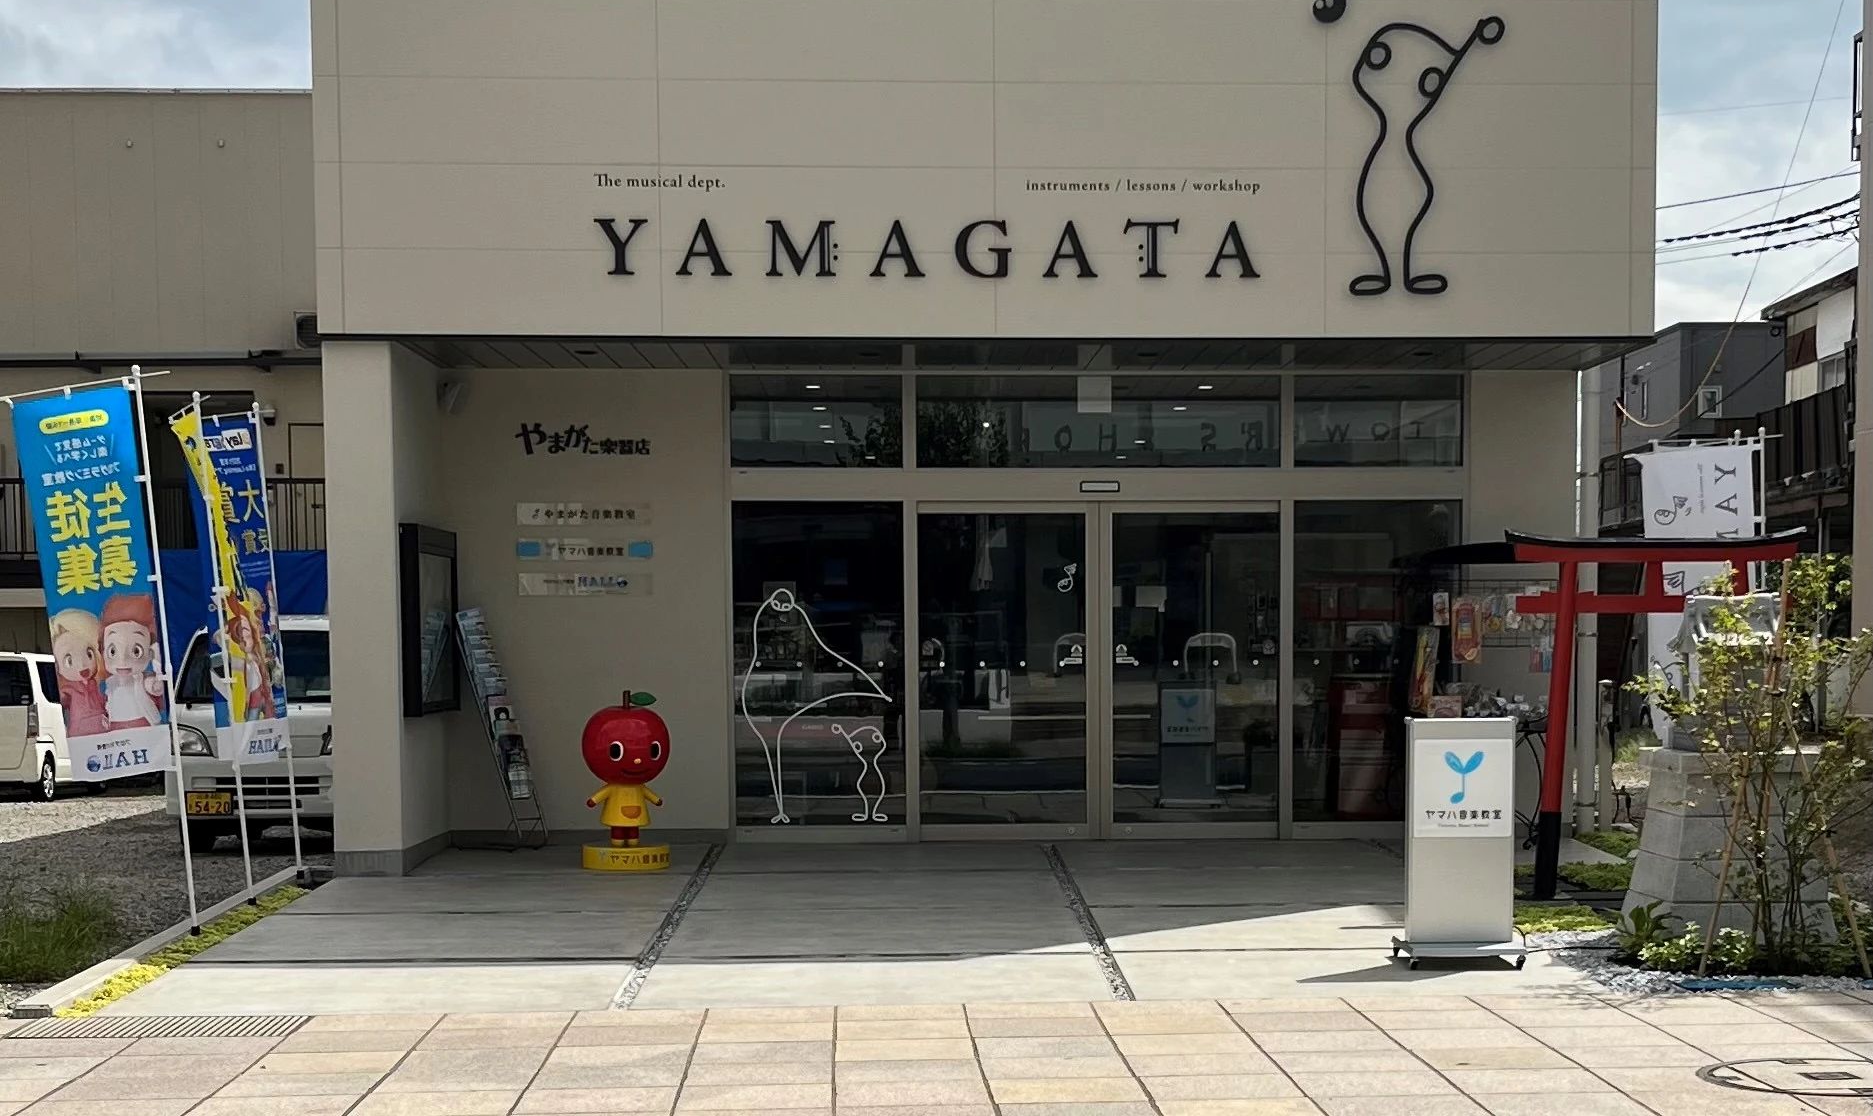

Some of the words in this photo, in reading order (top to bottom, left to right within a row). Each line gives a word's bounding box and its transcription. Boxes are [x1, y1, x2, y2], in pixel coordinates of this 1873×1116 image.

[595, 173, 622, 188] The
[626, 174, 683, 188] musical
[687, 174, 726, 192] dept.
[1025, 179, 1110, 192] instruments
[1126, 179, 1176, 192] lessons
[1192, 179, 1261, 195] workshop
[593, 217, 1261, 279] YAMAGATA
[1425, 809, 1503, 820] ヤマハ音楽教室
